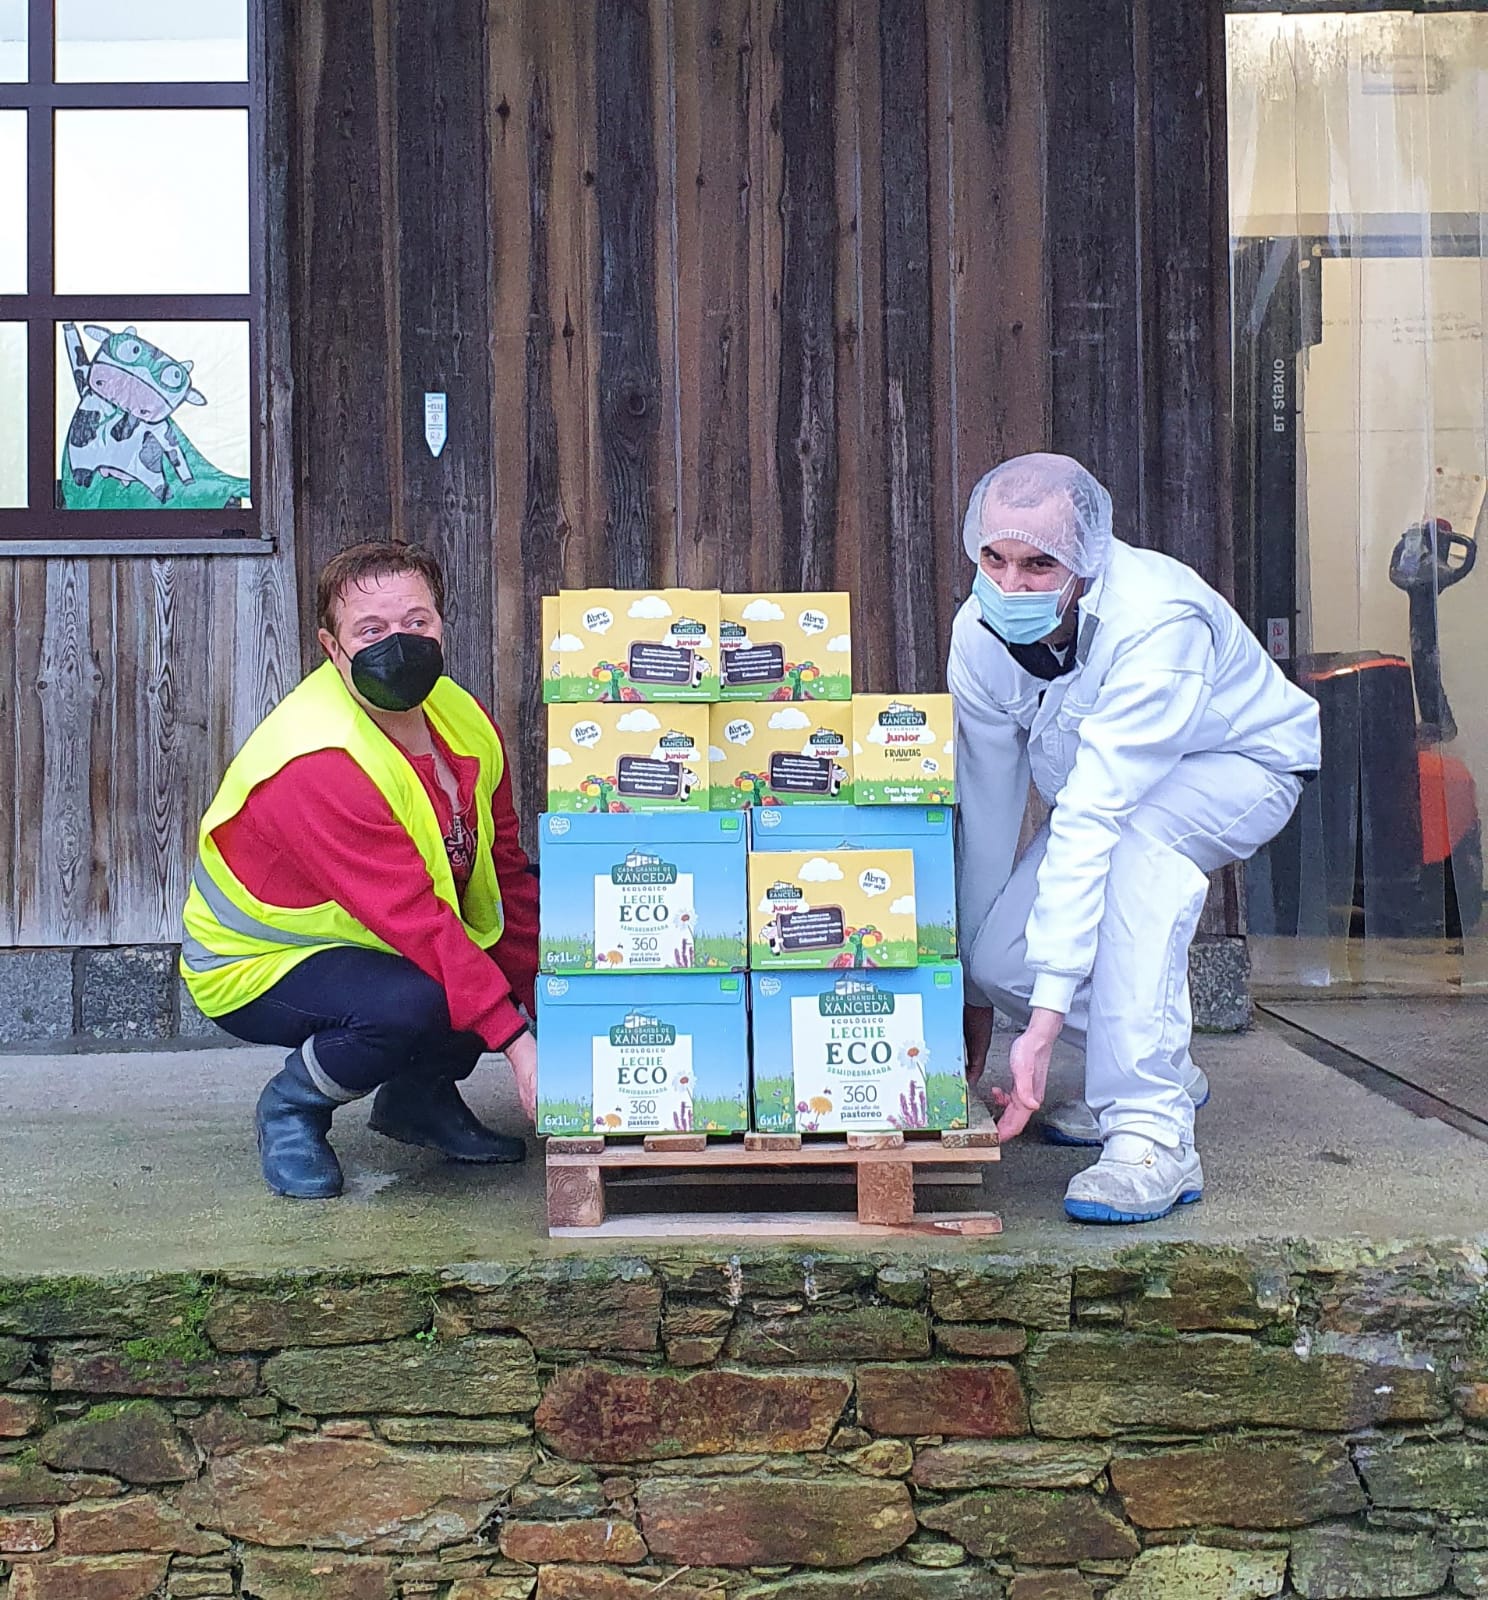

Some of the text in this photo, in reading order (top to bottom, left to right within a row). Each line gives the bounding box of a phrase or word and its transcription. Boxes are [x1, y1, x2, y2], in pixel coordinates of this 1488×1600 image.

[1273, 414, 1285, 432] BT
[586, 611, 607, 624] Abre
[803, 611, 824, 625] Abre
[675, 639, 702, 648] Junior
[720, 641, 742, 649] unior
[881, 716, 924, 725] XANCEDA
[575, 724, 596, 738] Abre
[728, 722, 749, 736] Abre
[885, 732, 921, 744] Junior
[664, 751, 691, 761] Junior
[814, 748, 840, 758] Junior
[616, 872, 673, 883] XANCEDA
[864, 871, 886, 884] Abre
[623, 895, 665, 905] LECHE
[619, 904, 669, 922] ECO
[772, 903, 799, 913] Junior
[631, 937, 658, 951] 360
[629, 956, 661, 964] pastoreo
[824, 1001, 891, 1014] XANCEDA
[830, 1026, 886, 1039] LECHE
[614, 1034, 672, 1045] XANCEDA
[825, 1040, 892, 1065] ECO
[621, 1056, 663, 1066] LECHE
[617, 1066, 668, 1085] ECO
[827, 1065, 892, 1077] SEMIDESNATADA
[843, 1084, 878, 1103] 360
[630, 1099, 657, 1114] 360
[840, 1110, 882, 1120] pastoreo
